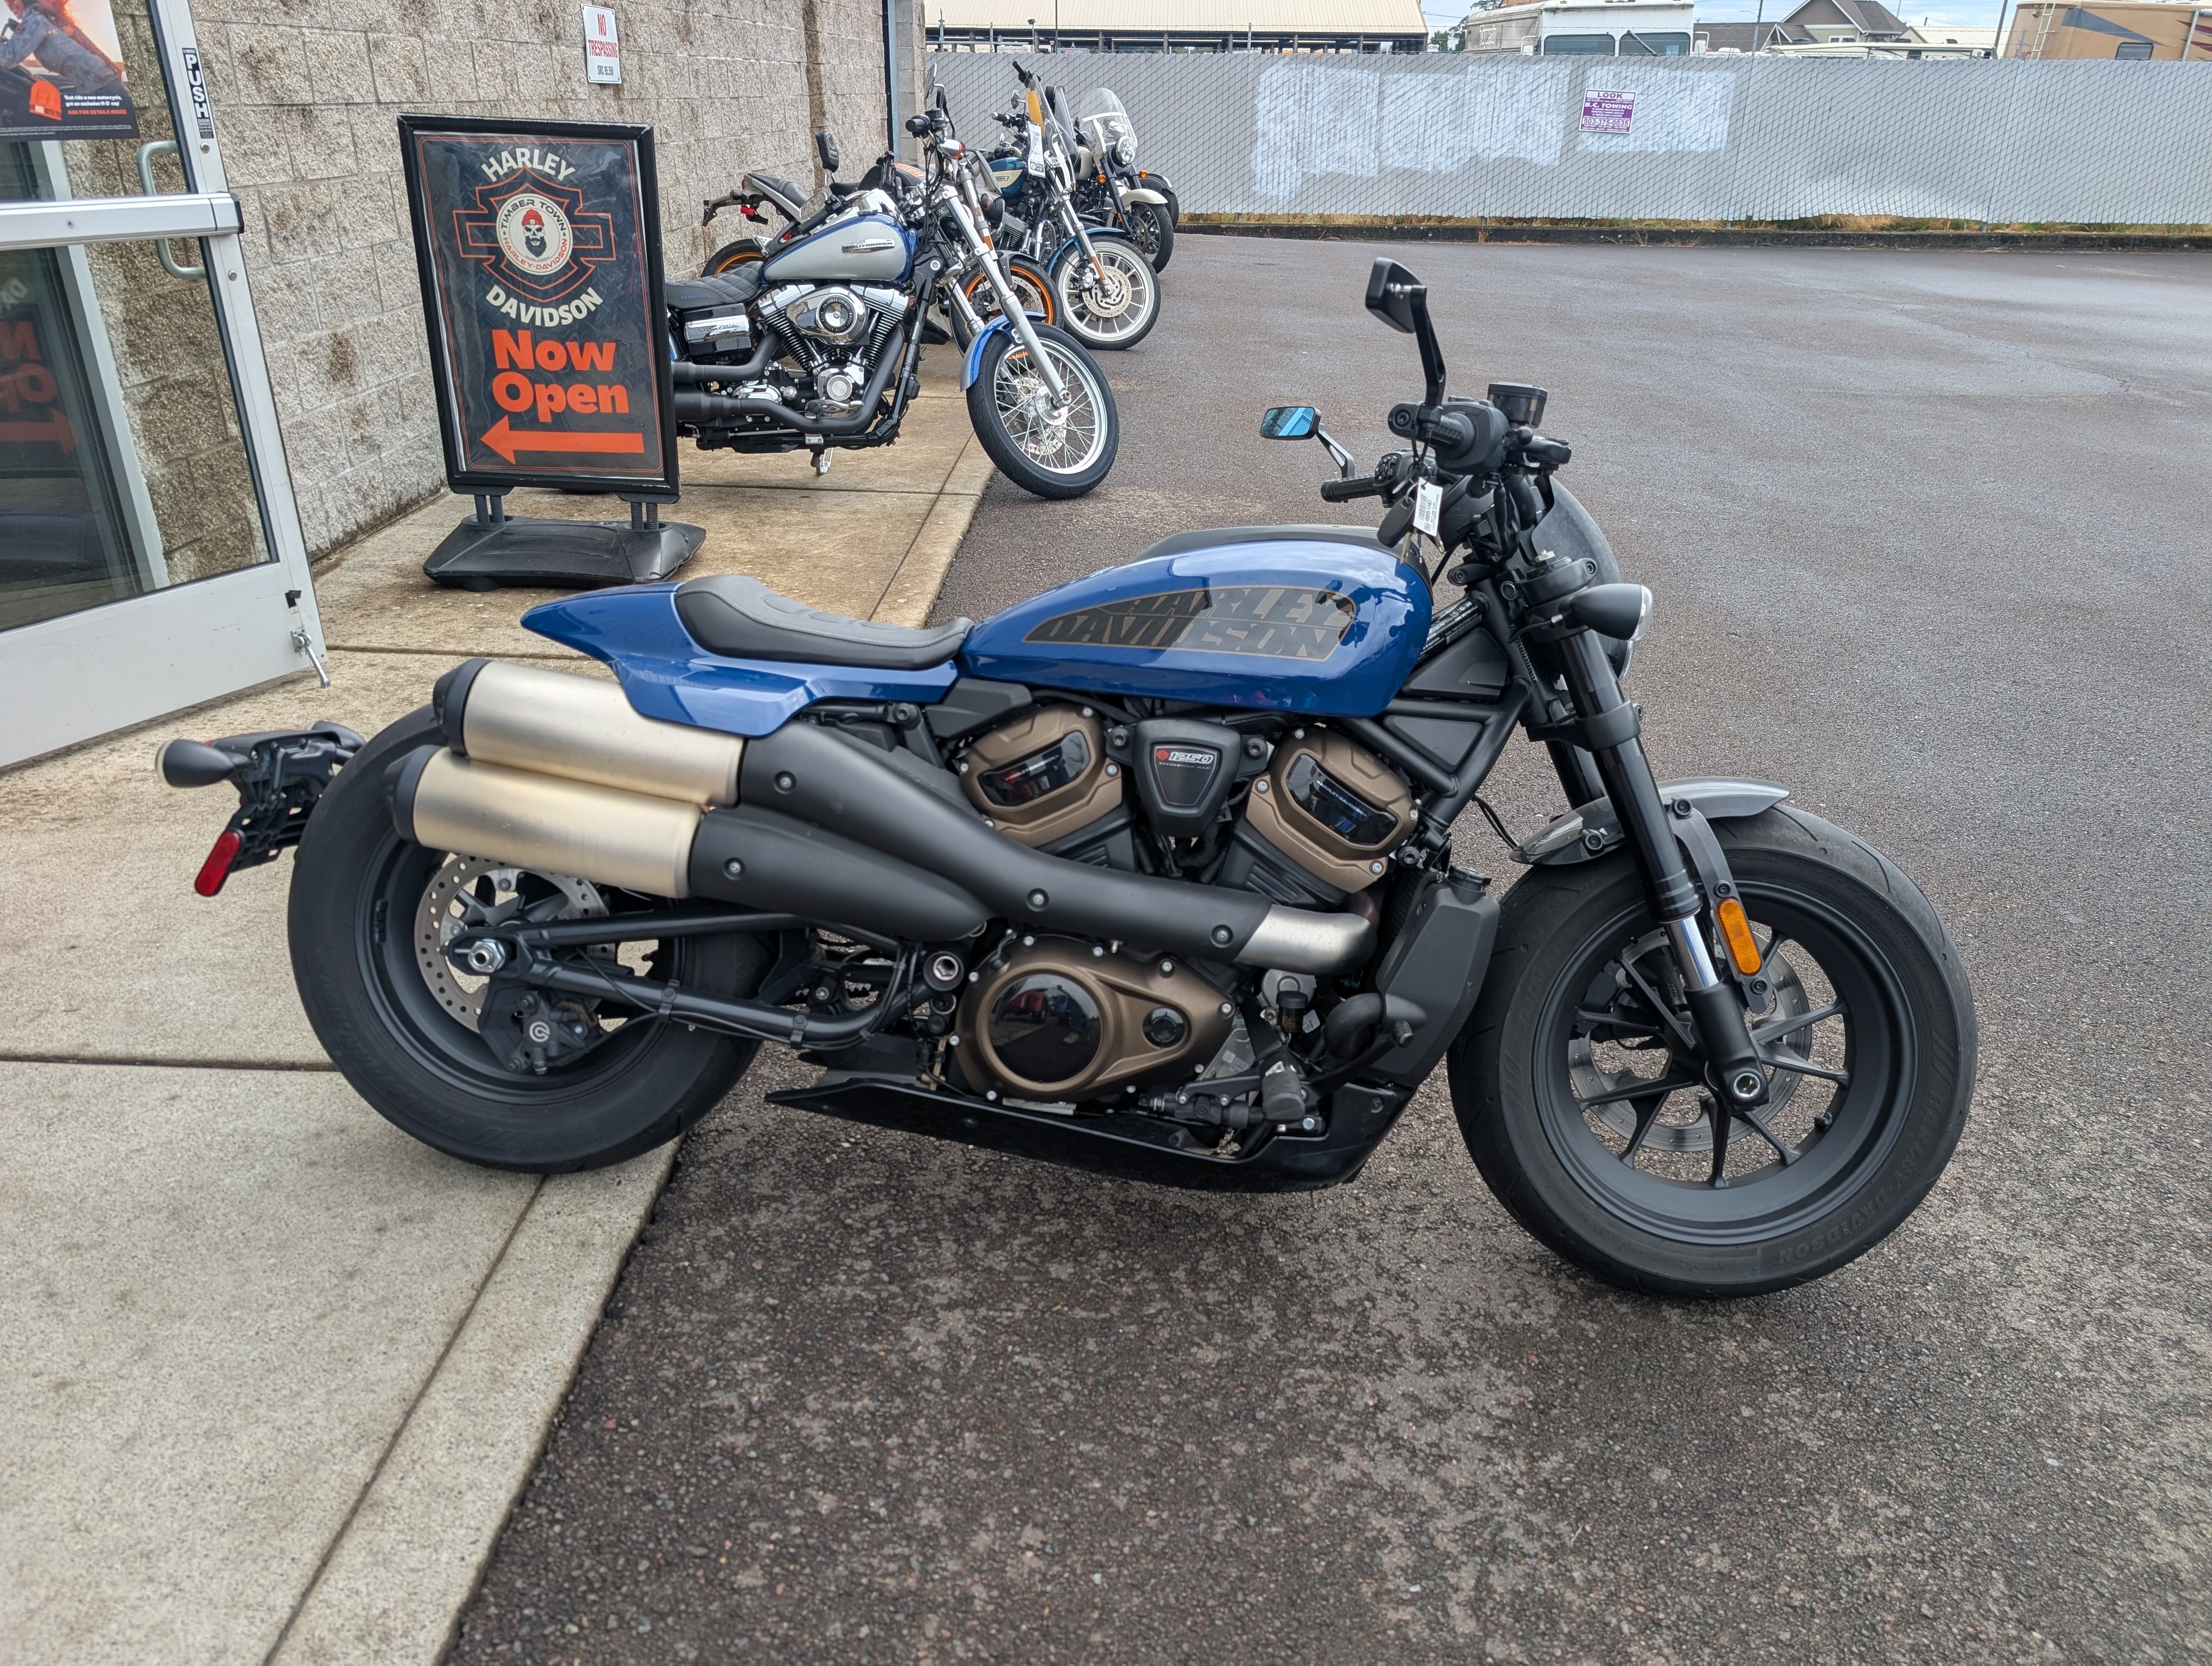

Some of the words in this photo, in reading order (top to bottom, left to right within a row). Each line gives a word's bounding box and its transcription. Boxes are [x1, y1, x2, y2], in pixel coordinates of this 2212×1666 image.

[597, 14, 607, 36] NO
[588, 40, 618, 58] TRESPASSING
[185, 54, 209, 118] PUSH
[481, 148, 576, 182] HARLEY
[501, 199, 535, 230] TIMBER
[539, 201, 567, 231] TOWN
[503, 238, 568, 270] HARLEY-DAVIDSON
[486, 285, 603, 326] DAVIDSON
[492, 329, 616, 371] Now
[492, 371, 629, 422] Open
[1168, 751, 1214, 764] 1250
[1320, 782, 1365, 815] HARLEY-DAVIDSON
